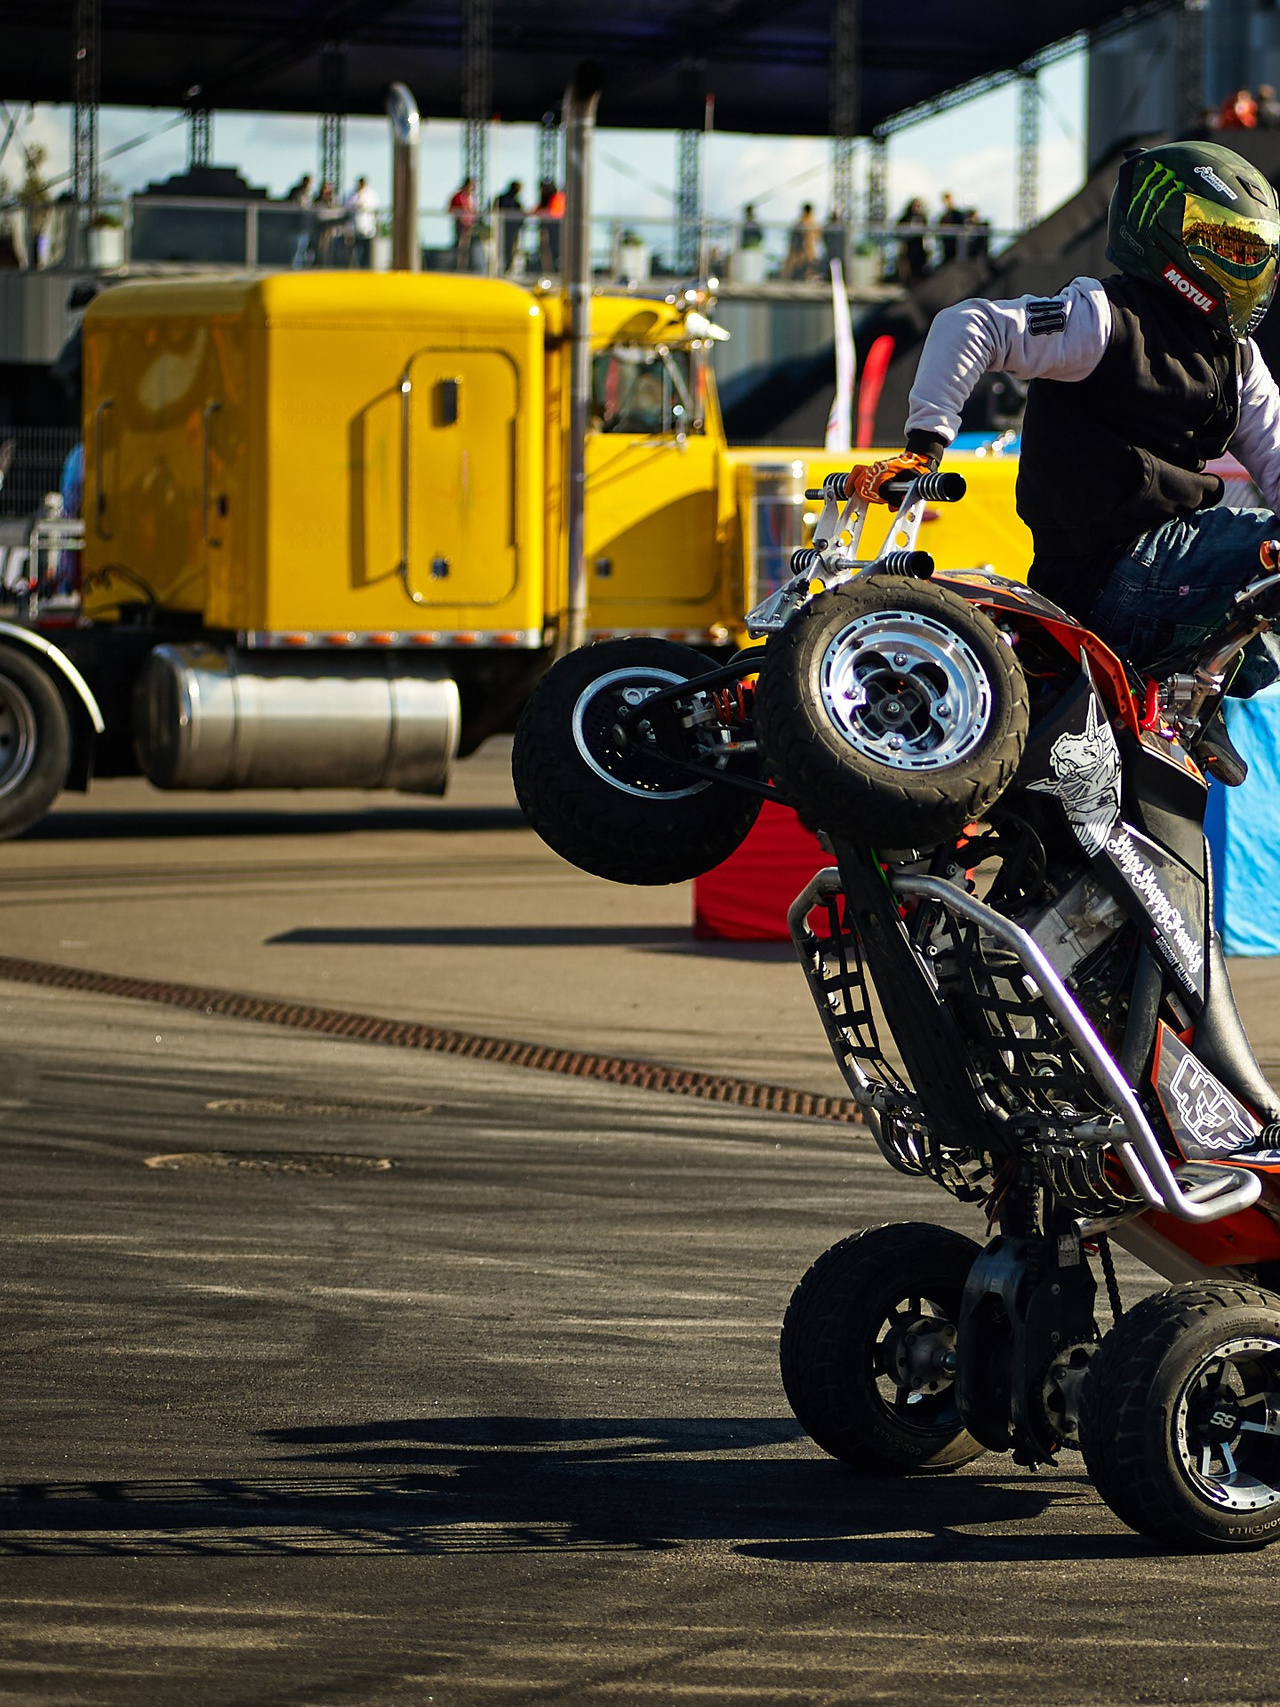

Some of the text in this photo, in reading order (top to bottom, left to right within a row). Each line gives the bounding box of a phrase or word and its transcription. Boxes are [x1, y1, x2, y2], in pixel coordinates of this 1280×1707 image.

[1164, 269, 1213, 312] MOTUL
[1155, 936, 1197, 994] GRIGORIY TALDYKIN
[1210, 1411, 1236, 1429] SS
